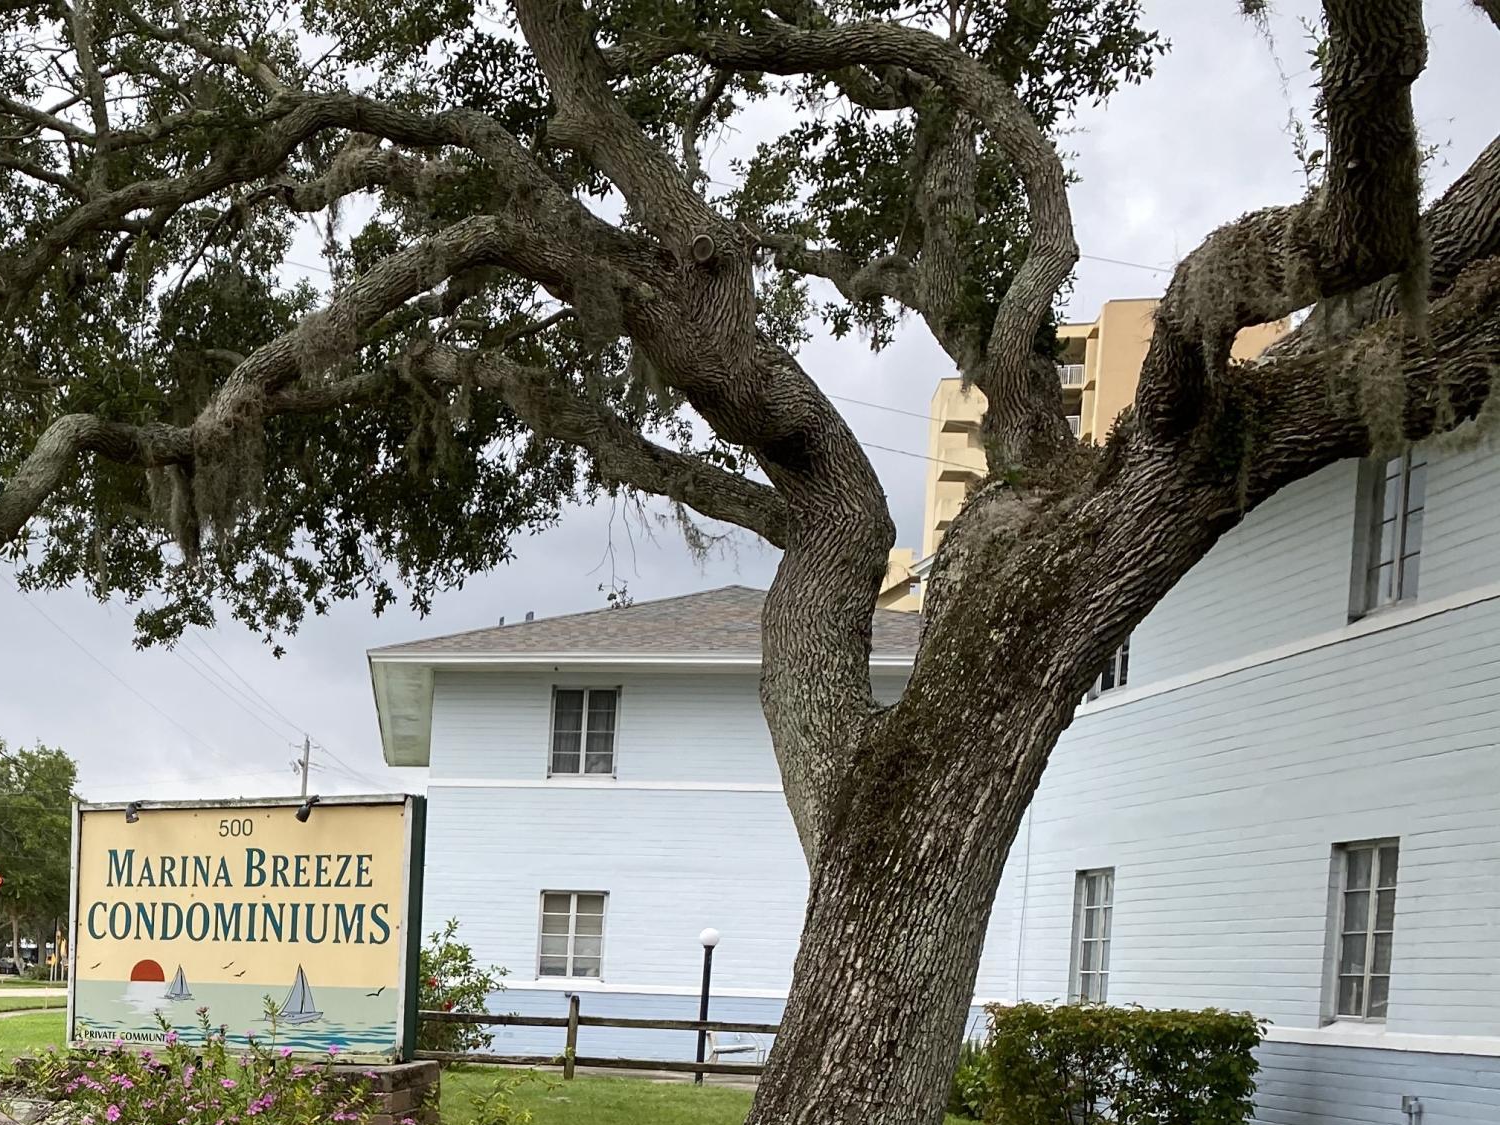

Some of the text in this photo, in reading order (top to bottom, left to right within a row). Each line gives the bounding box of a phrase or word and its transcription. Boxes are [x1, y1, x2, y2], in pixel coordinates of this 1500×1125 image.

[218, 818, 254, 838] 500
[106, 847, 373, 888] MARINA BREEZE
[87, 900, 391, 945] CONDOMINIUMS
[84, 1030, 117, 1040] PRIVATE
[119, 1031, 166, 1042] COMMUNI
